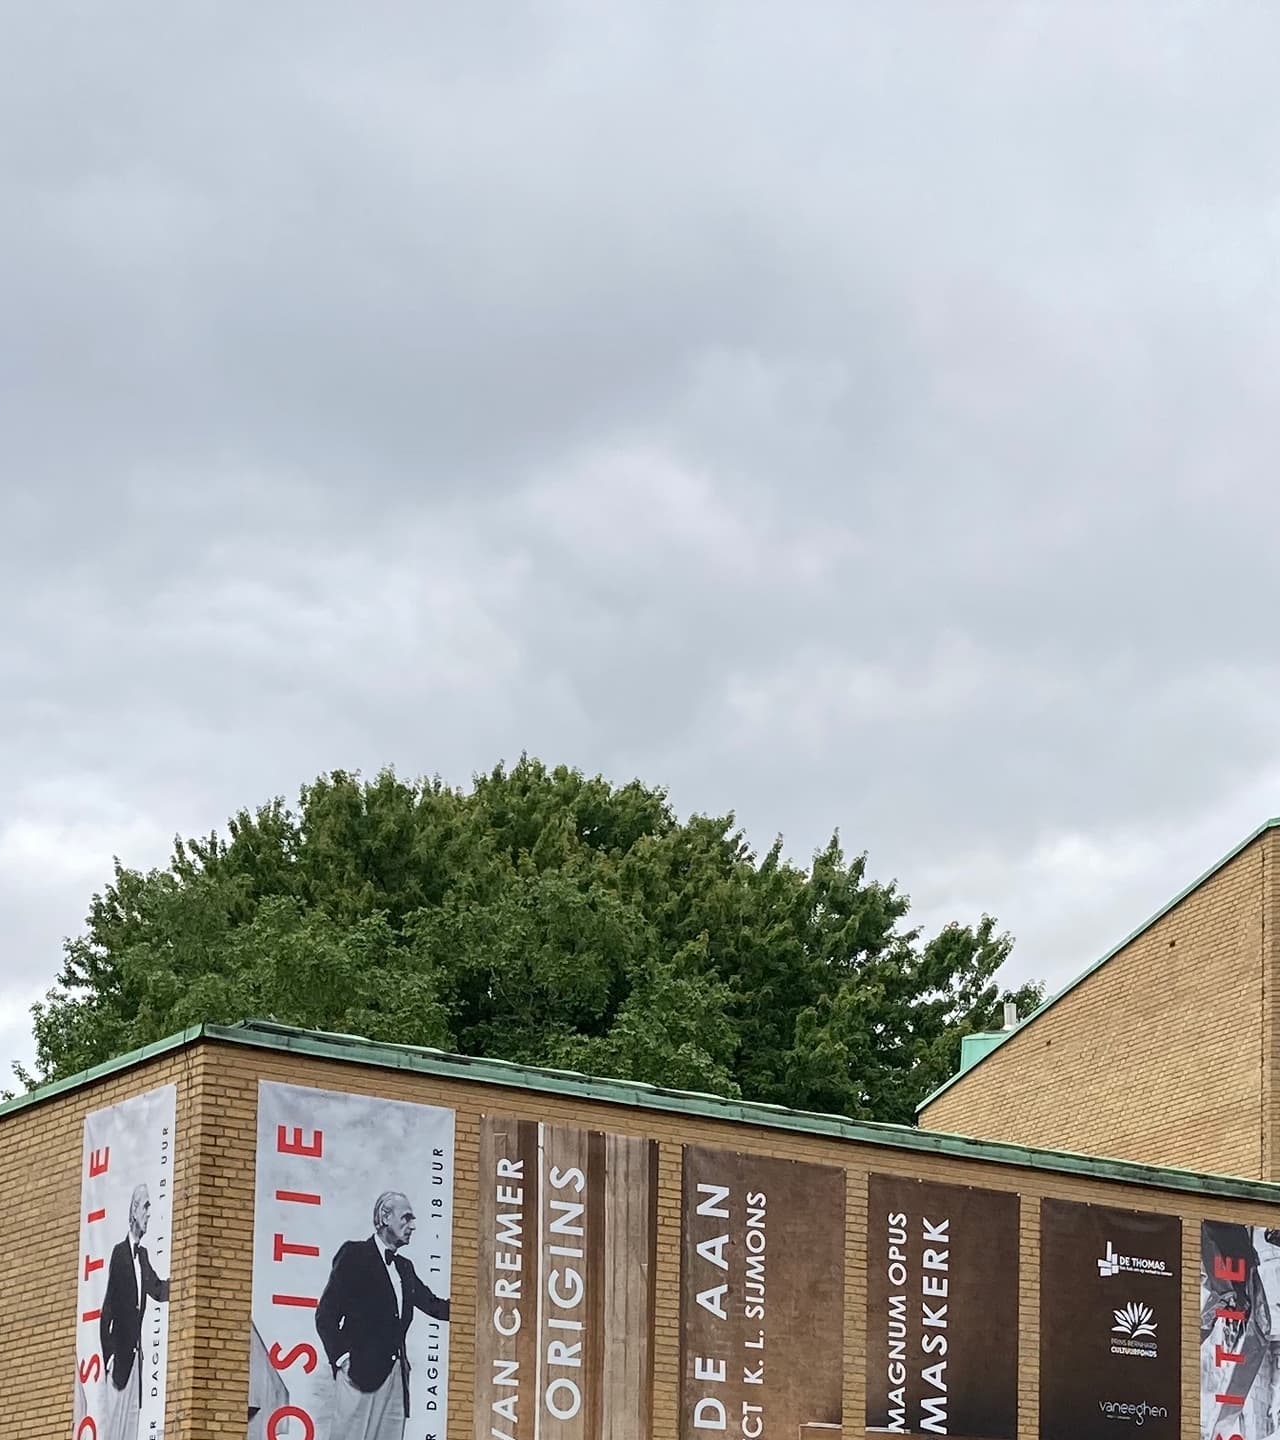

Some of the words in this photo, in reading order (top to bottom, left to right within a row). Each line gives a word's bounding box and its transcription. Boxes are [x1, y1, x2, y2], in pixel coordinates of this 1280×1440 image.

[432, 1148, 444, 1185] UUR
[431, 1198, 443, 1218] 18
[150, 1306, 162, 1397] DAGELIJ
[161, 1127, 169, 1165] UUR
[430, 1254, 441, 1273] 11
[493, 1157, 524, 1337] CREMER
[695, 1184, 730, 1320] AAN
[745, 1192, 767, 1319] SIJMONS
[888, 1212, 908, 1286] OPUS
[1120, 1256, 1130, 1266] DE
[1131, 1258, 1165, 1271] THOMAS
[546, 1167, 584, 1420] ORIGINS
[427, 1322, 440, 1411] DAGELIJ
[743, 1360, 764, 1384] K.
[744, 1329, 764, 1349] L.
[886, 1296, 907, 1433] MAGNUM
[1099, 1400, 1167, 1425] vaneeghen
